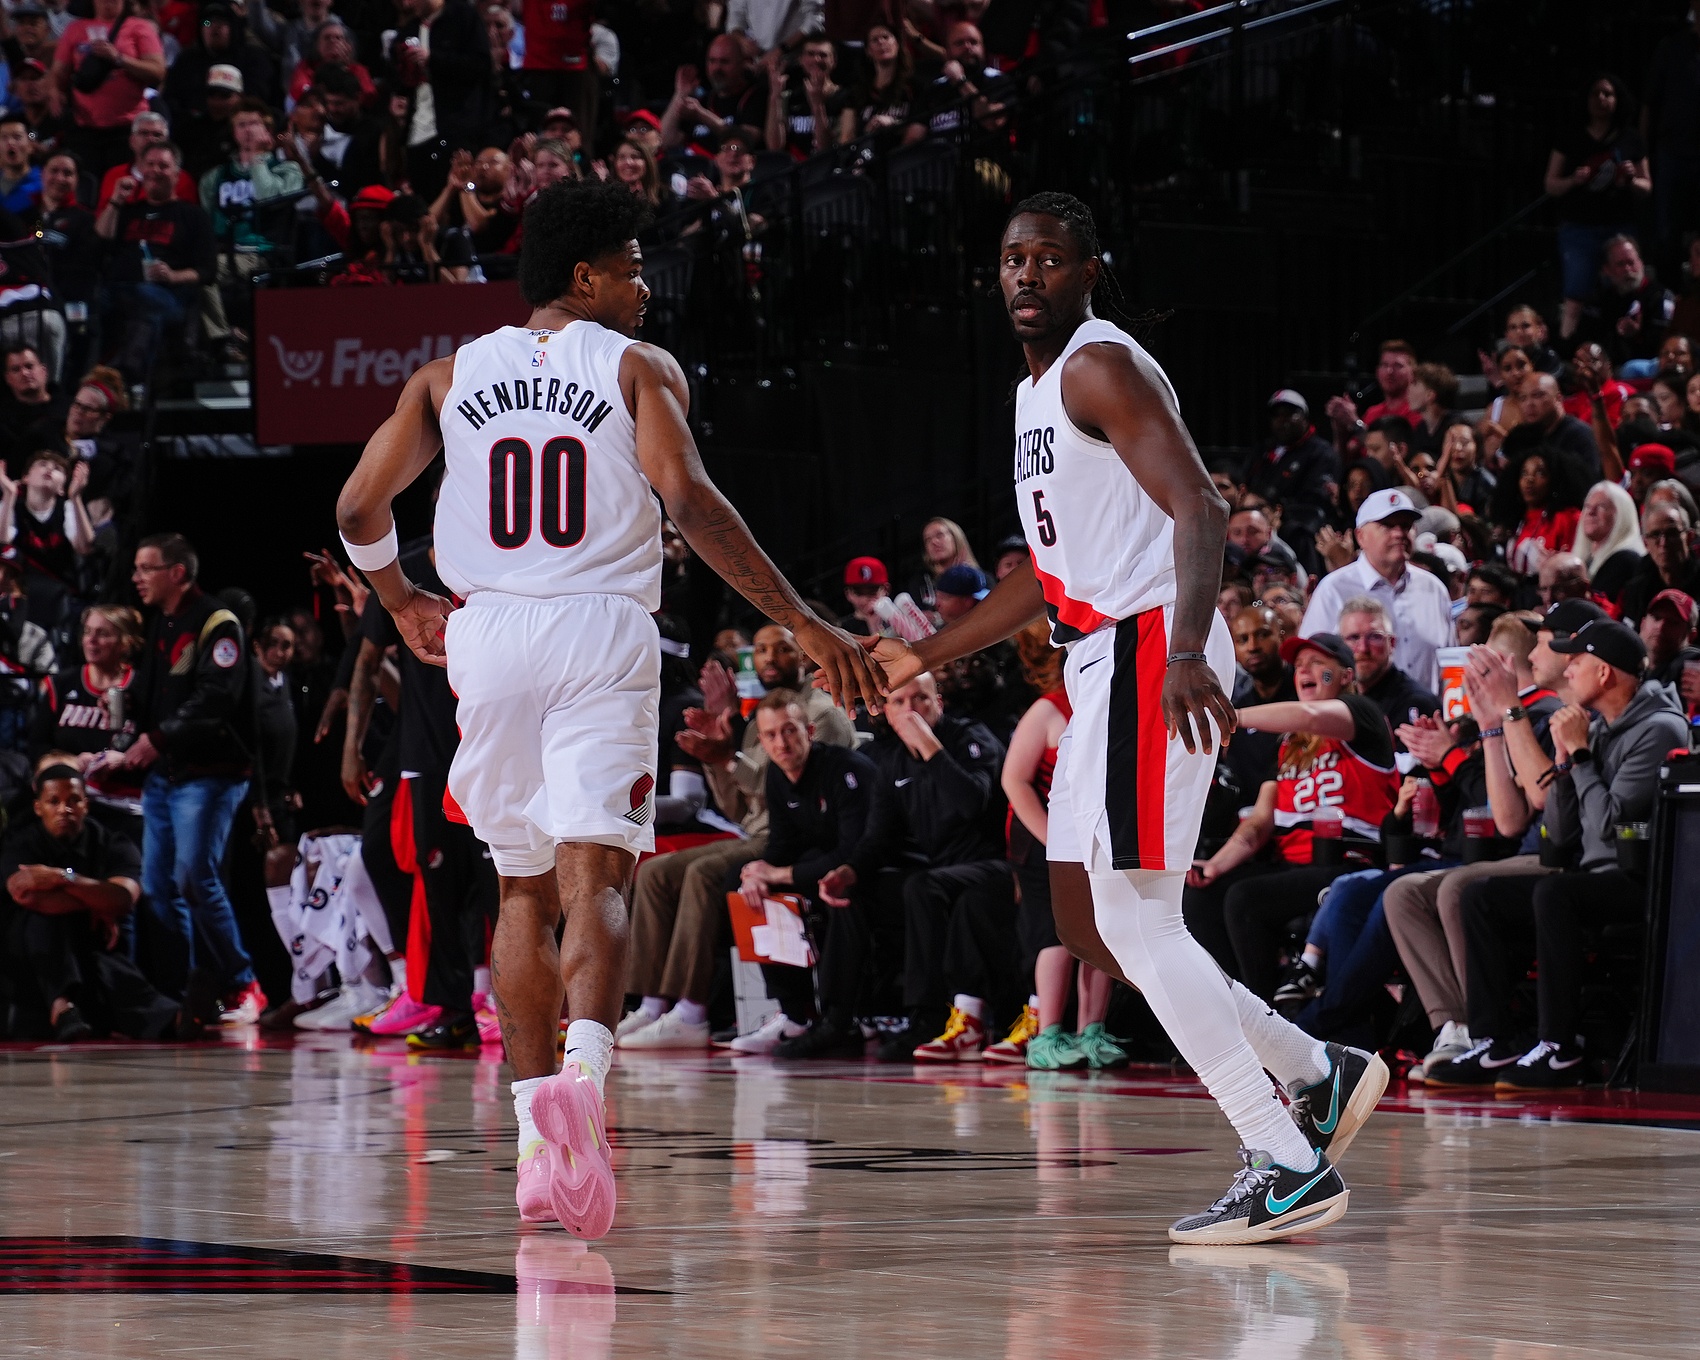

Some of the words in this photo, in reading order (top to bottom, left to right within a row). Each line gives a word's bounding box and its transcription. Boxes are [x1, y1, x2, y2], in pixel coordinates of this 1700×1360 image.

[331, 335, 476, 387] Fred
[457, 378, 613, 434] HENDERSON
[1015, 426, 1055, 486] AZERS
[489, 435, 587, 550] 00
[1032, 489, 1057, 547] 5
[1293, 770, 1344, 813] 22
